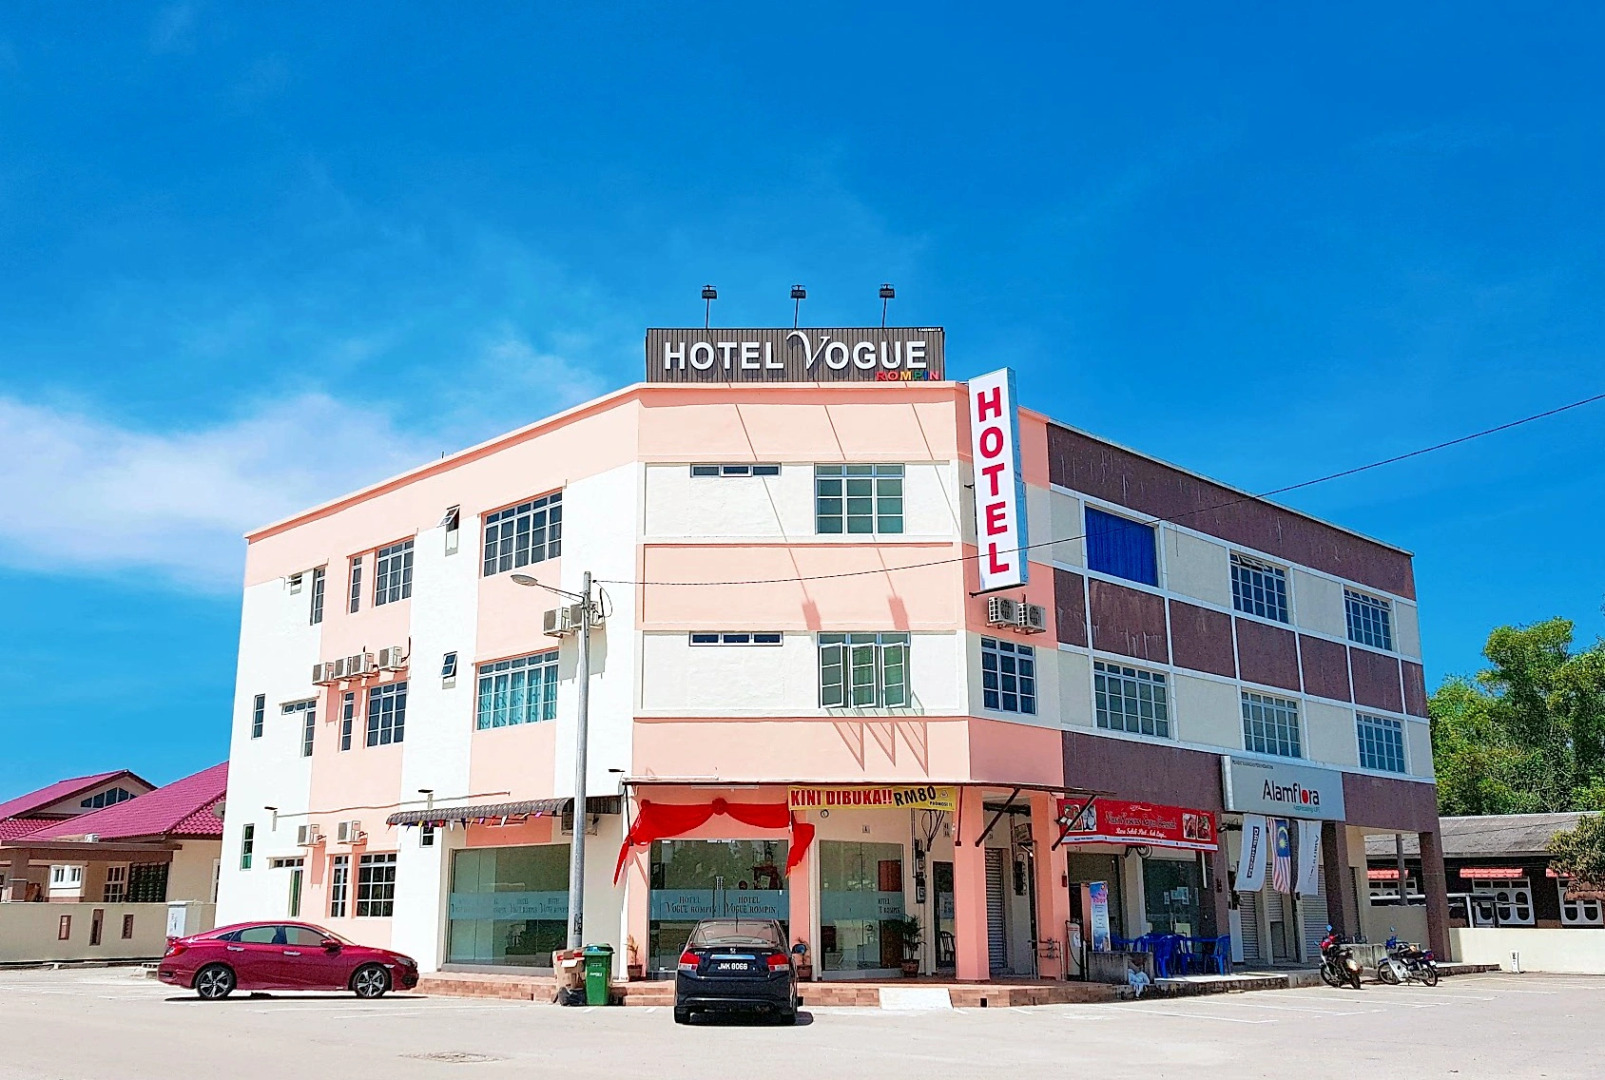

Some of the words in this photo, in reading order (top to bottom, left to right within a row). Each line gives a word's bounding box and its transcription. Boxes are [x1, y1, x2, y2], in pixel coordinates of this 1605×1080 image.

[664, 341, 785, 370] HOTEL
[786, 330, 927, 371] VOGUE
[876, 371, 940, 381] ROMPIN
[977, 386, 1010, 575] HOTEL
[790, 789, 821, 806] KINI
[825, 789, 893, 806] DIBUKA!!
[894, 785, 936, 806] RM80
[1262, 779, 1320, 806] Alamflora
[679, 896, 701, 904] HOTEL
[738, 896, 761, 904] HOTEL
[749, 905, 777, 914] ROMPIN
